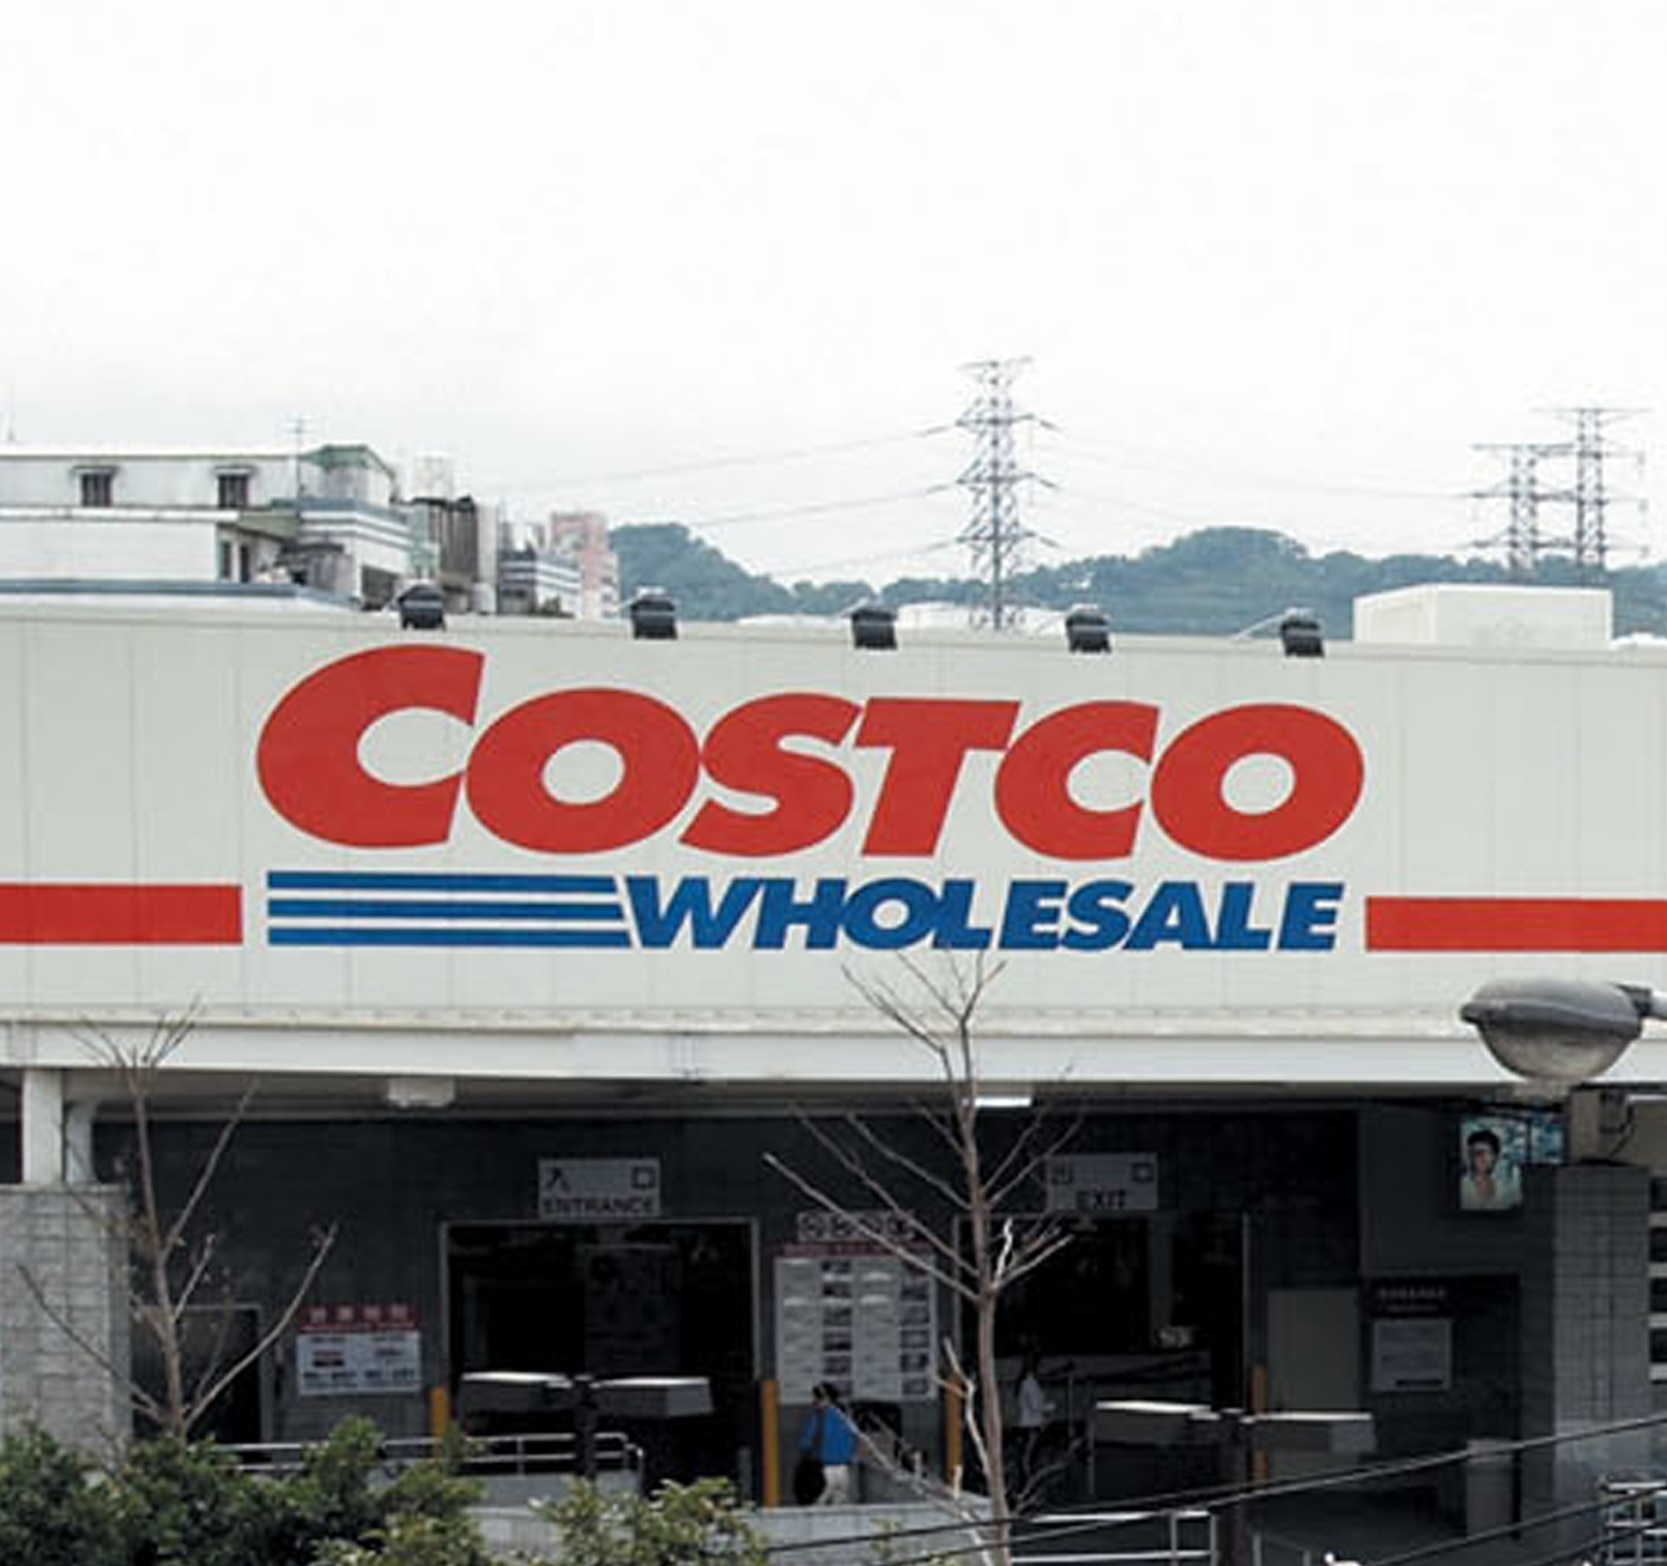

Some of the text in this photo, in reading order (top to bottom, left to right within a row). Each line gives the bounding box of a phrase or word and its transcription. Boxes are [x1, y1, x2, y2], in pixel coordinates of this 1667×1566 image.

[256, 643, 1364, 862] COSTCO
[619, 875, 1345, 951] WHOLESALE
[1076, 1190, 1127, 1209] EXIT
